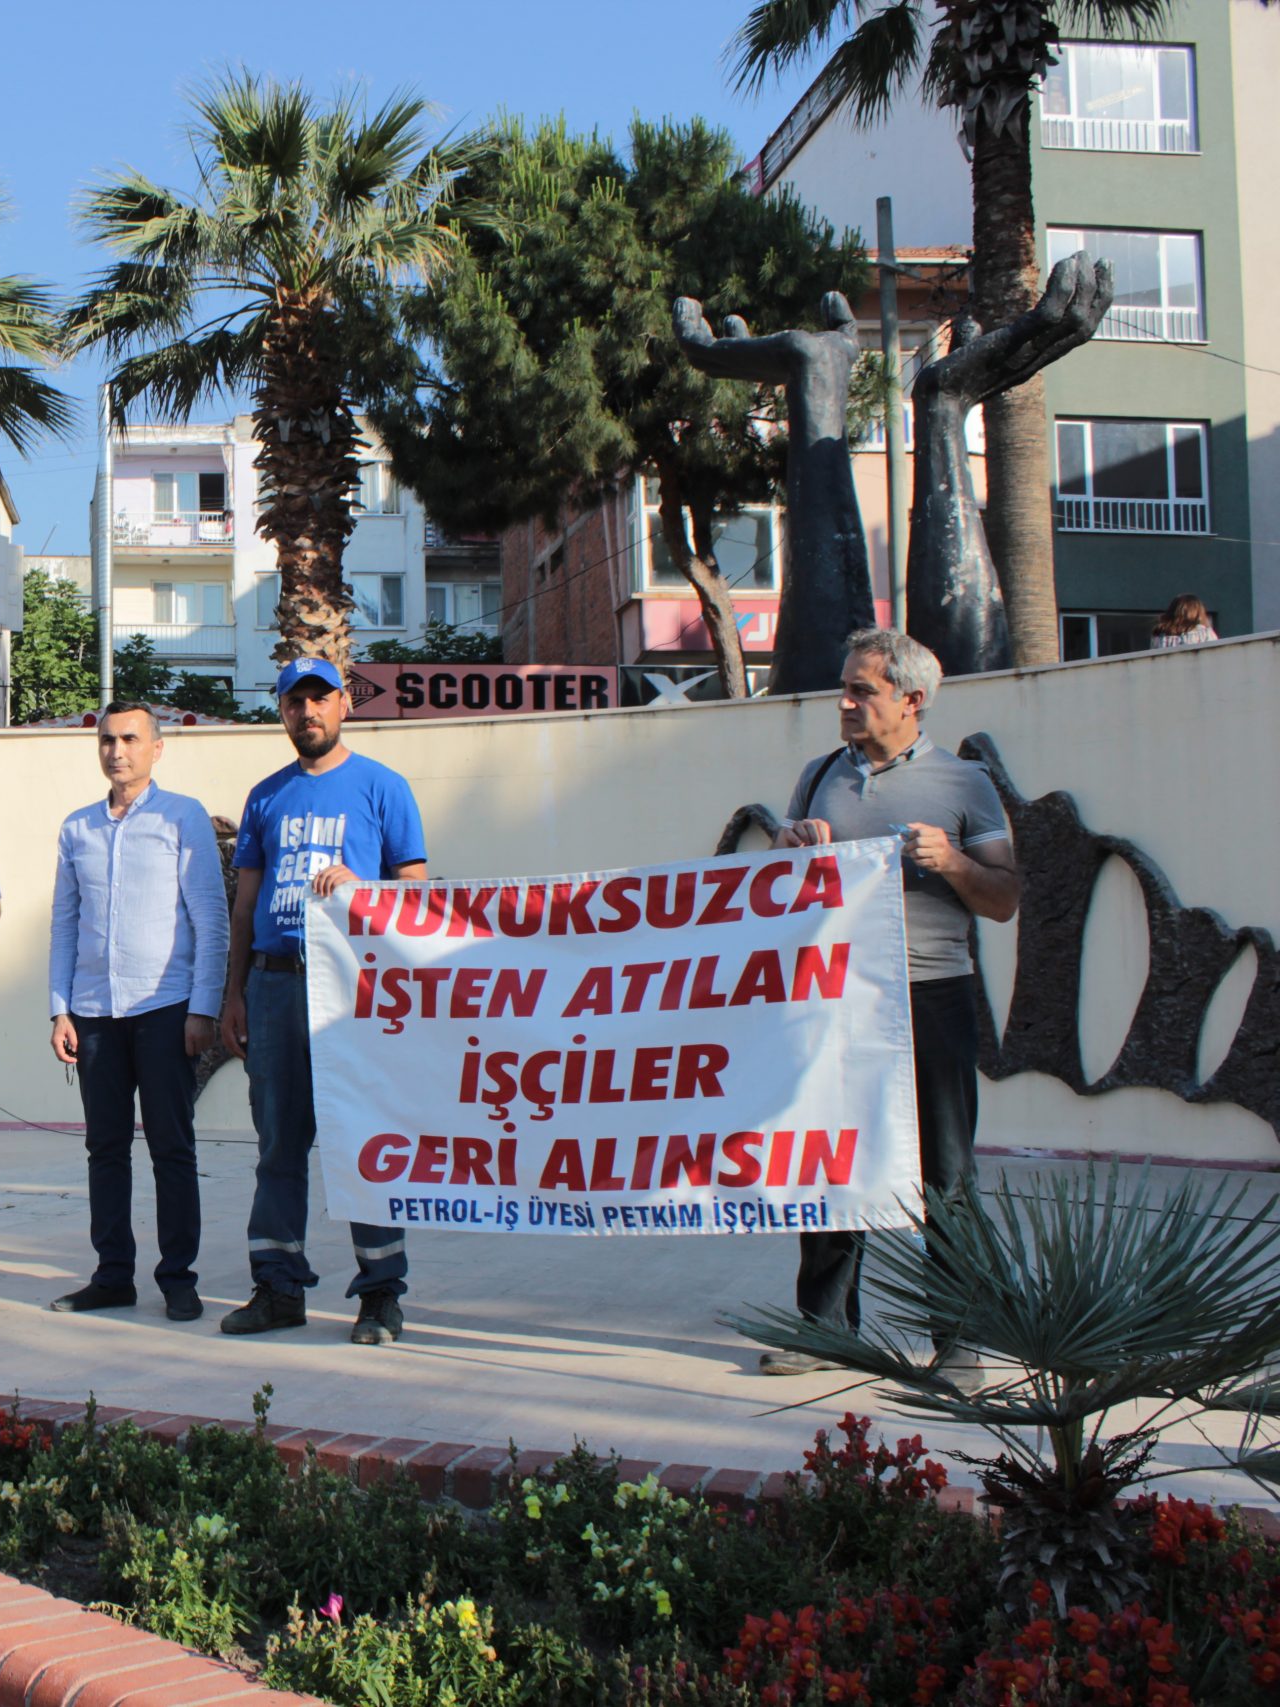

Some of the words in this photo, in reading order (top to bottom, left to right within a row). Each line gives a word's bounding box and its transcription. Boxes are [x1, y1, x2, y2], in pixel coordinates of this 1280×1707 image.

[395, 672, 609, 710] SCOOTER
[280, 812, 345, 852] İŞİMİ
[348, 855, 844, 937] HUKUKSUZCA
[353, 952, 547, 1034] İŞTEN
[560, 942, 851, 1018] ATILAN
[459, 1034, 730, 1121] İŞÇİLER
[357, 1122, 517, 1186] GERİ
[538, 1129, 859, 1192] ALINSIN
[388, 1195, 519, 1231] PETROL-İŞ
[528, 1196, 596, 1229] ÜYESİ
[602, 1199, 703, 1229] PETKİM
[713, 1196, 828, 1234] İŞÇİLERİ
